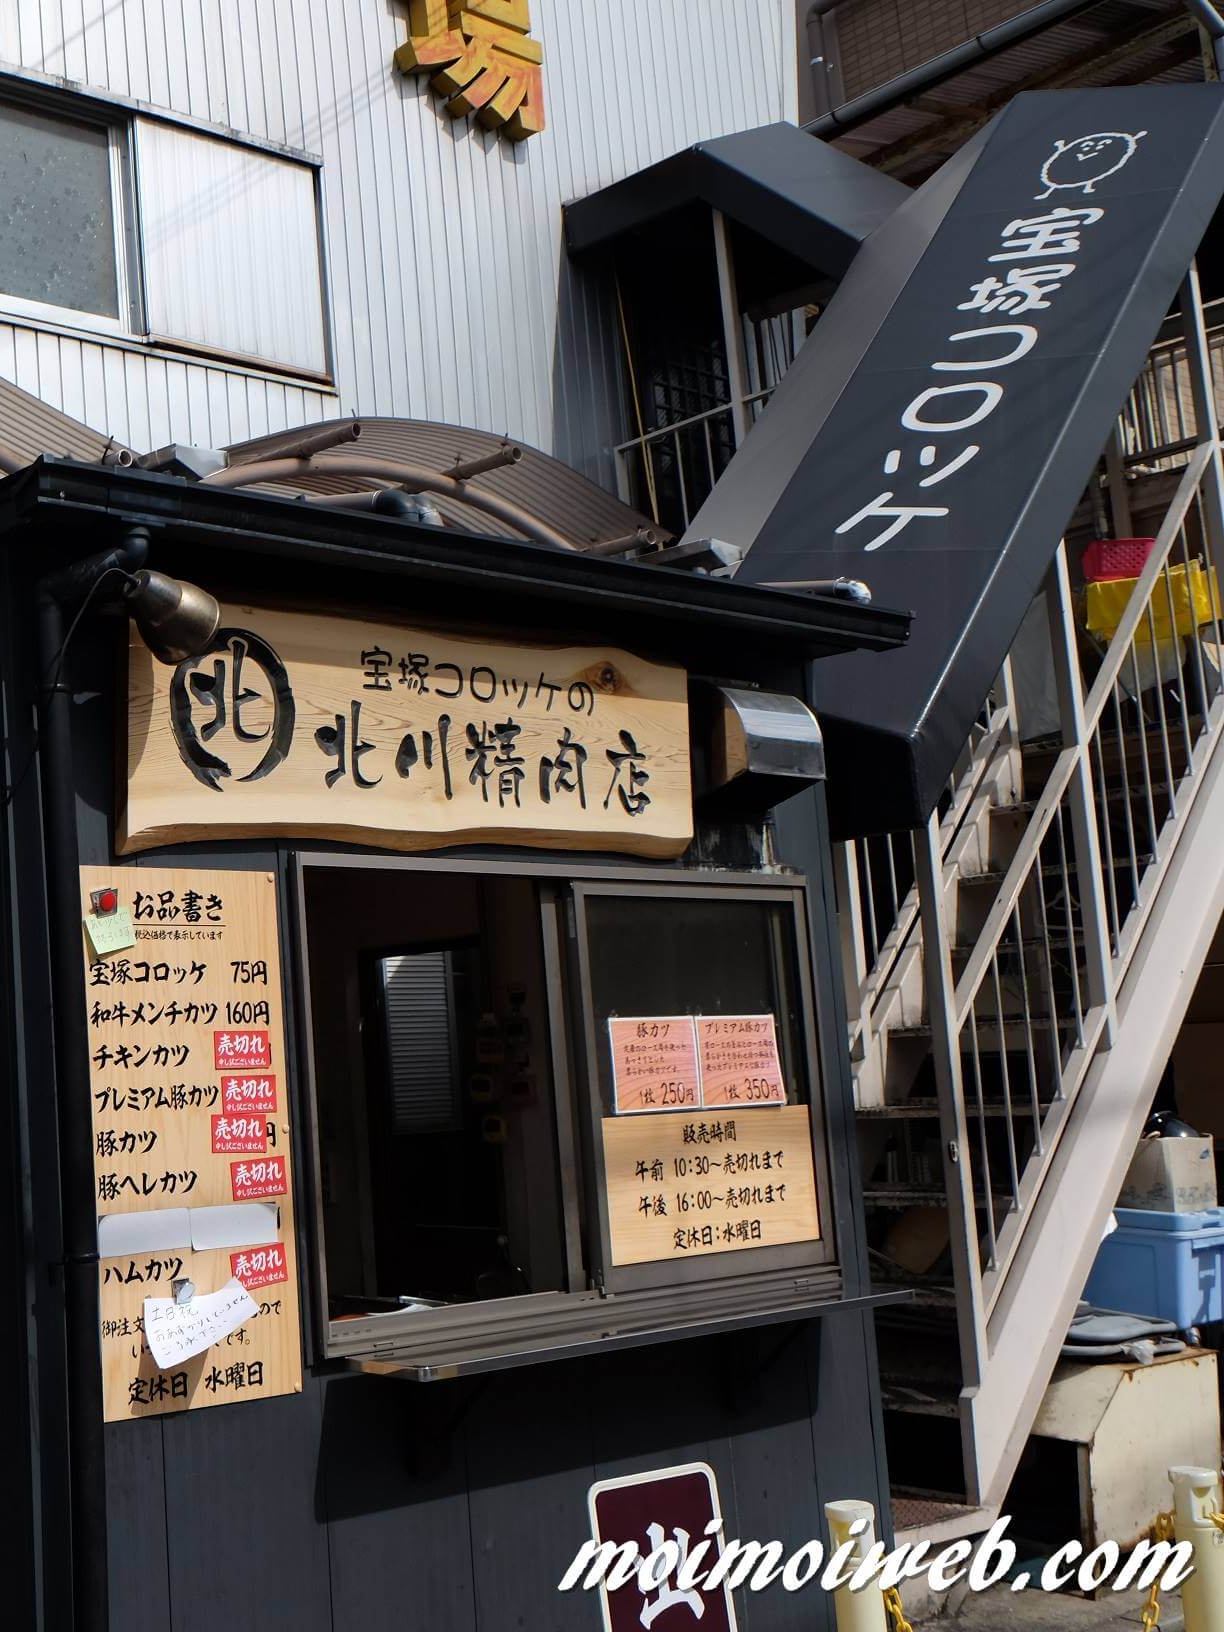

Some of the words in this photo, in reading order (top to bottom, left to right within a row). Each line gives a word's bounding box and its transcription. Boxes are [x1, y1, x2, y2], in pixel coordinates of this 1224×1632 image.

[835, 207, 1104, 550] 宝塚コロッケ
[360, 645, 595, 716] 宝塚コロッケの
[315, 700, 652, 817] 北川精肉店
[133, 890, 223, 922] お品書き
[135, 929, 223, 941] 税込価格で表示しています
[89, 959, 207, 986] 宝塚コロッケ
[230, 960, 268, 986] 75円
[90, 1001, 218, 1028] 和牛メンチカツ
[226, 1001, 270, 1026] 160円
[637, 1022, 670, 1038] 豚カツ
[92, 1044, 190, 1070] チキンカツ
[218, 1034, 265, 1056] 売切れ
[94, 1084, 220, 1113] プレミアム豚カツ
[225, 1078, 273, 1101] 売切れ
[661, 1082, 694, 1105] 250円
[745, 1078, 779, 1100] 350円
[215, 1117, 263, 1140] 売切れ
[683, 1121, 737, 1145] 販売時間
[96, 1129, 158, 1156] 豚カツ
[235, 1161, 282, 1186] 売切れ
[635, 1159, 665, 1183] 午前
[98, 1170, 198, 1201] 豚ヘレカツ
[638, 1195, 668, 1219] 午後
[104, 1257, 183, 1285] ハムカツ
[235, 1249, 282, 1280] 売切れ
[128, 1372, 188, 1405] 定休日
[205, 1361, 264, 1393] 水曜日
